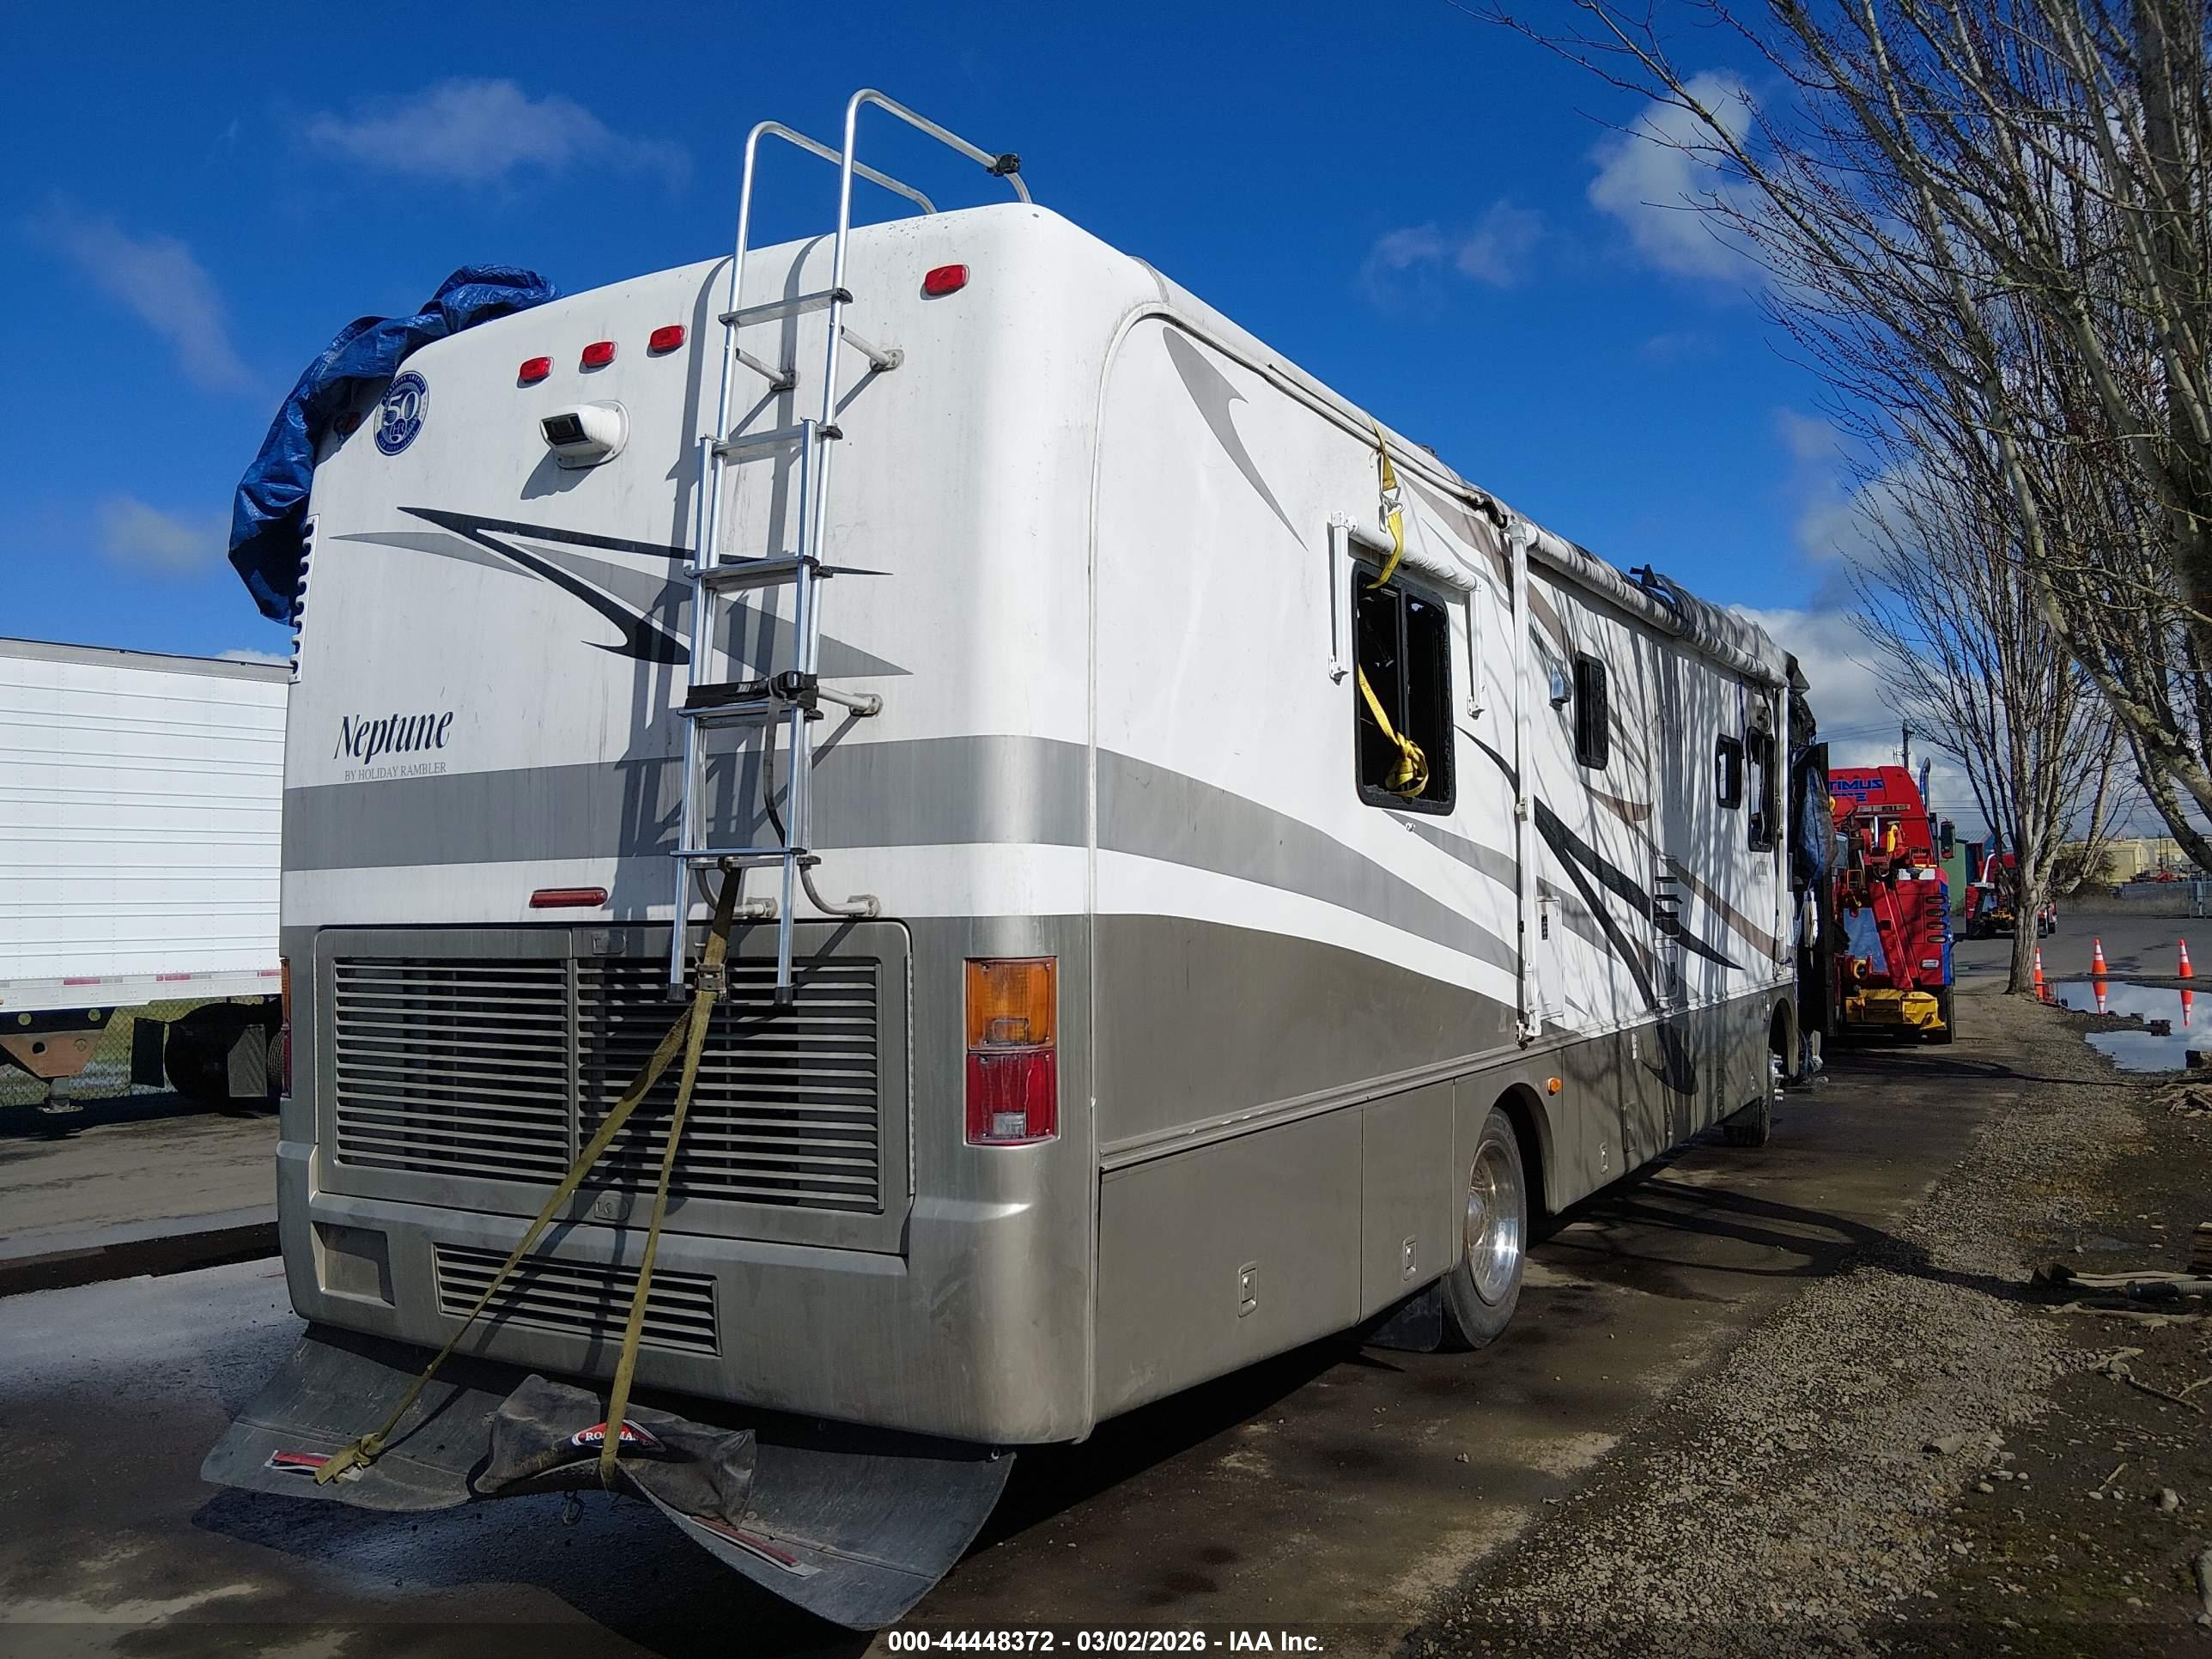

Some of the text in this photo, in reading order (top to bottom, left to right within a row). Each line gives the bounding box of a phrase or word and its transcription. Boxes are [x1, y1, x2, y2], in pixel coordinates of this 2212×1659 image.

[384, 392, 419, 426] 50
[334, 712, 453, 765] Neptune
[344, 762, 447, 781] BY HOLIDAY RAMBLER
[1829, 779, 1883, 790] TIMUS
